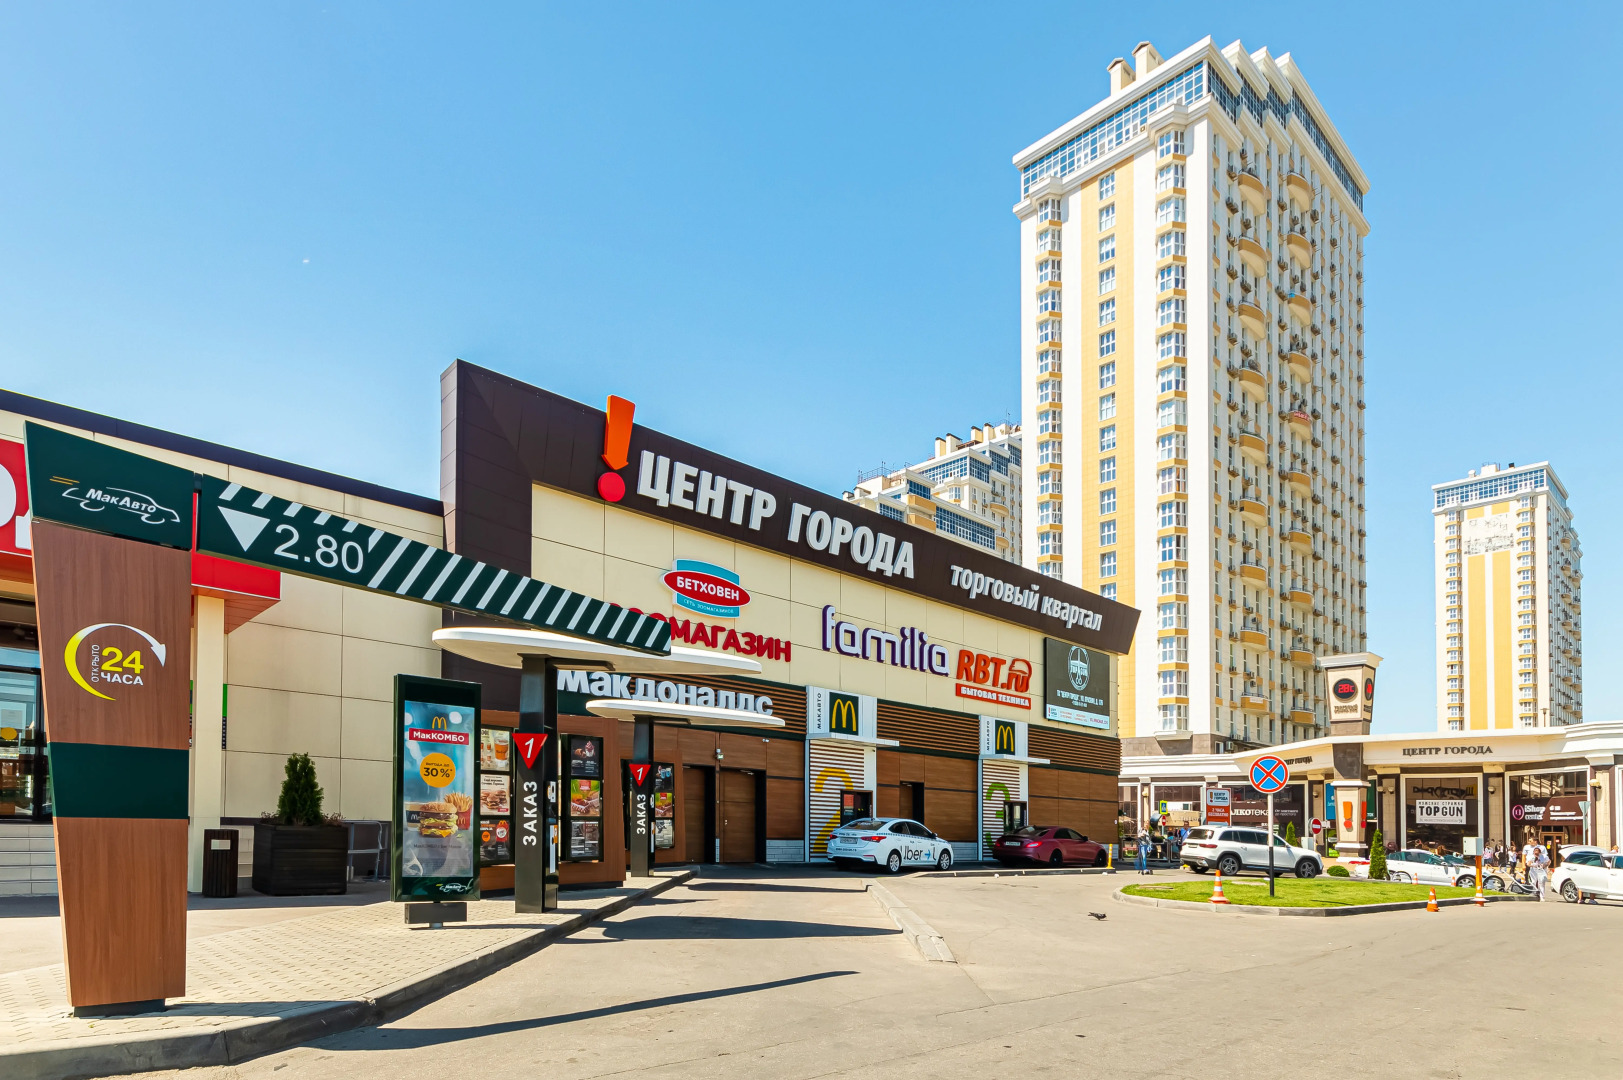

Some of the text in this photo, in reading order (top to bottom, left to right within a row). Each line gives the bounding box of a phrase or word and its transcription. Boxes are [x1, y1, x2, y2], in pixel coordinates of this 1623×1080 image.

[86, 488, 156, 513] МакАвто
[637, 450, 915, 579] ЦЕНТР ГОРОДА
[274, 524, 364, 574] 2.80
[677, 576, 739, 601] БЕТХОВЕН
[950, 565, 1103, 631] торговый квартал
[822, 604, 950, 677] familia
[91, 644, 100, 683] ОТКРЫТО
[101, 646, 144, 674] 24
[957, 650, 1032, 692] RBT.ru
[100, 672, 144, 685] ЧАСА
[961, 686, 1030, 707] БЫТОВАЯ ТЕХНИКА
[413, 731, 465, 742] МакКОМБО
[523, 737, 535, 759] 1
[1402, 746, 1493, 757] ЦЕНТР ГОРОДА
[637, 767, 644, 781] 1
[523, 781, 538, 846] ЗАКАЗ
[637, 794, 646, 835] ЗАКАЗ
[1419, 806, 1463, 817] TOP GUN
